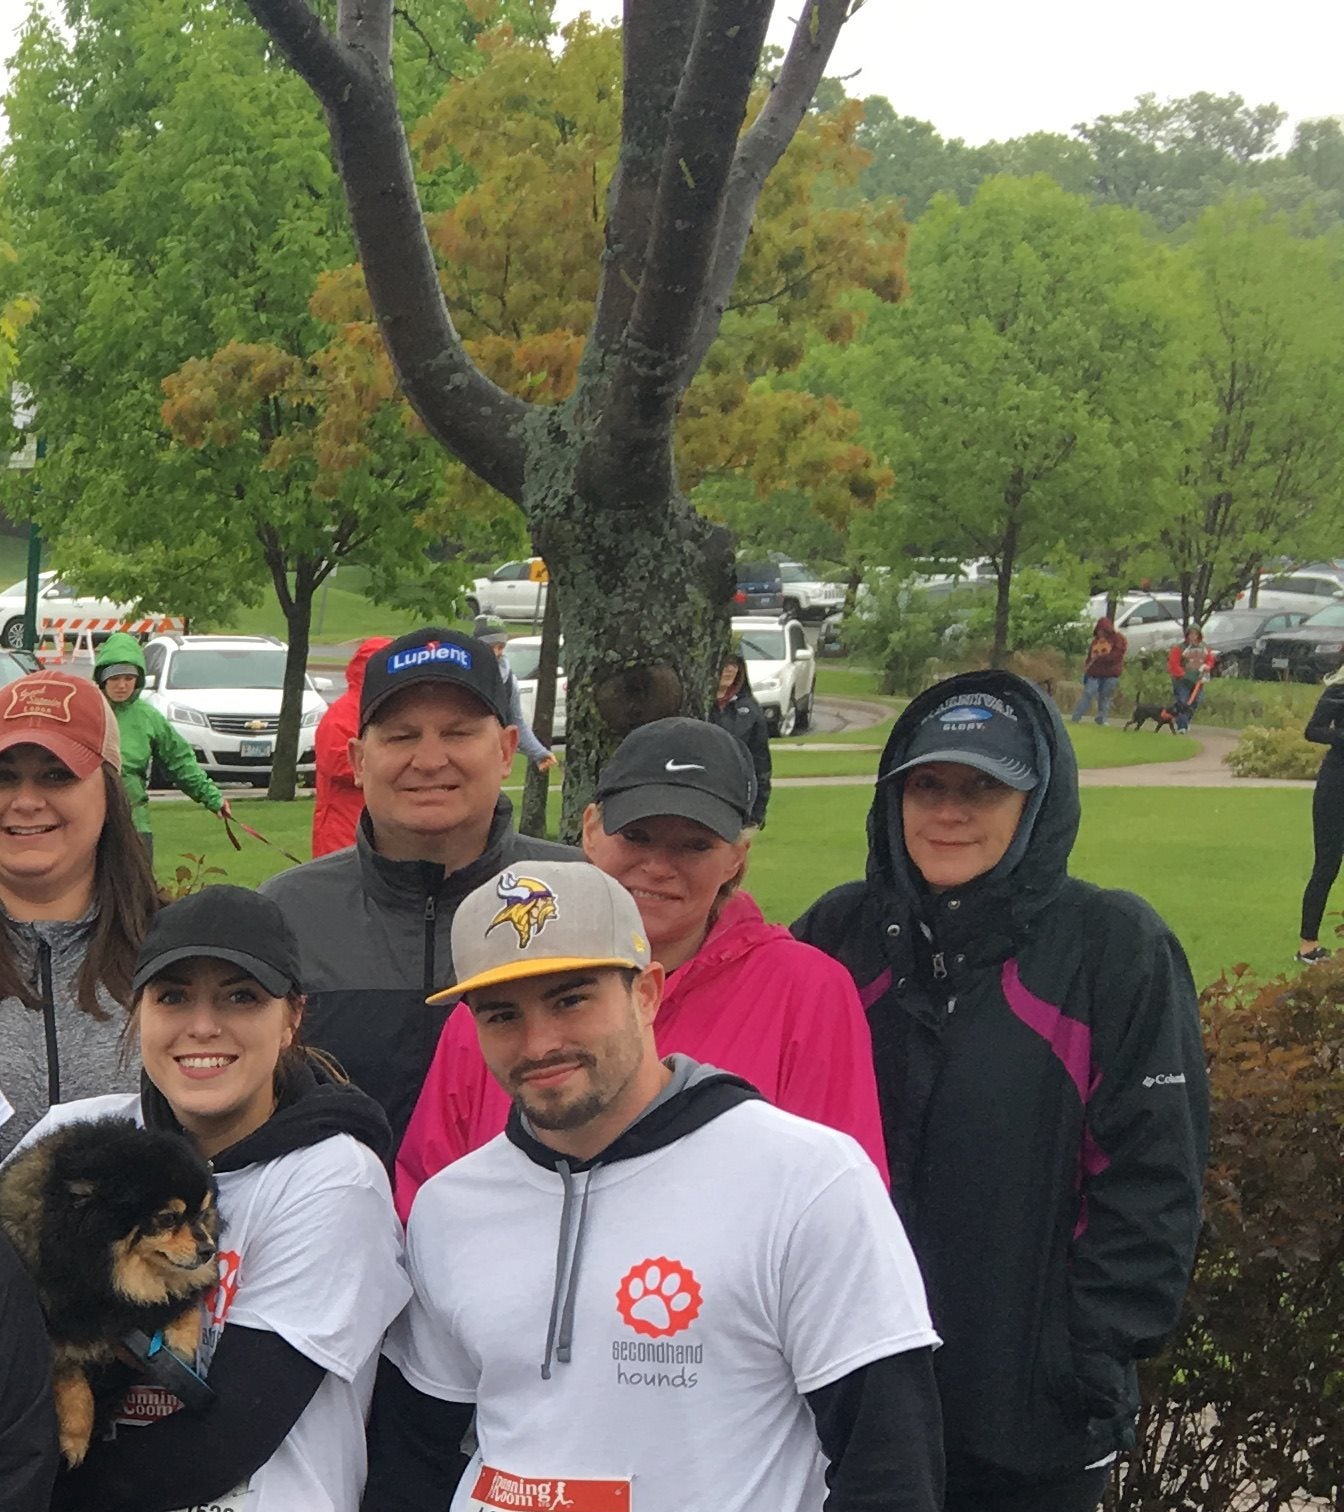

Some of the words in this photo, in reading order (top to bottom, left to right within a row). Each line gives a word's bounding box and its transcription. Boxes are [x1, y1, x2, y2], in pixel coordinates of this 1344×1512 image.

[393, 643, 468, 670] Lupient
[612, 1341, 703, 1364] secondhand
[617, 1362, 699, 1388] hounds
[124, 1391, 185, 1407] unnin
